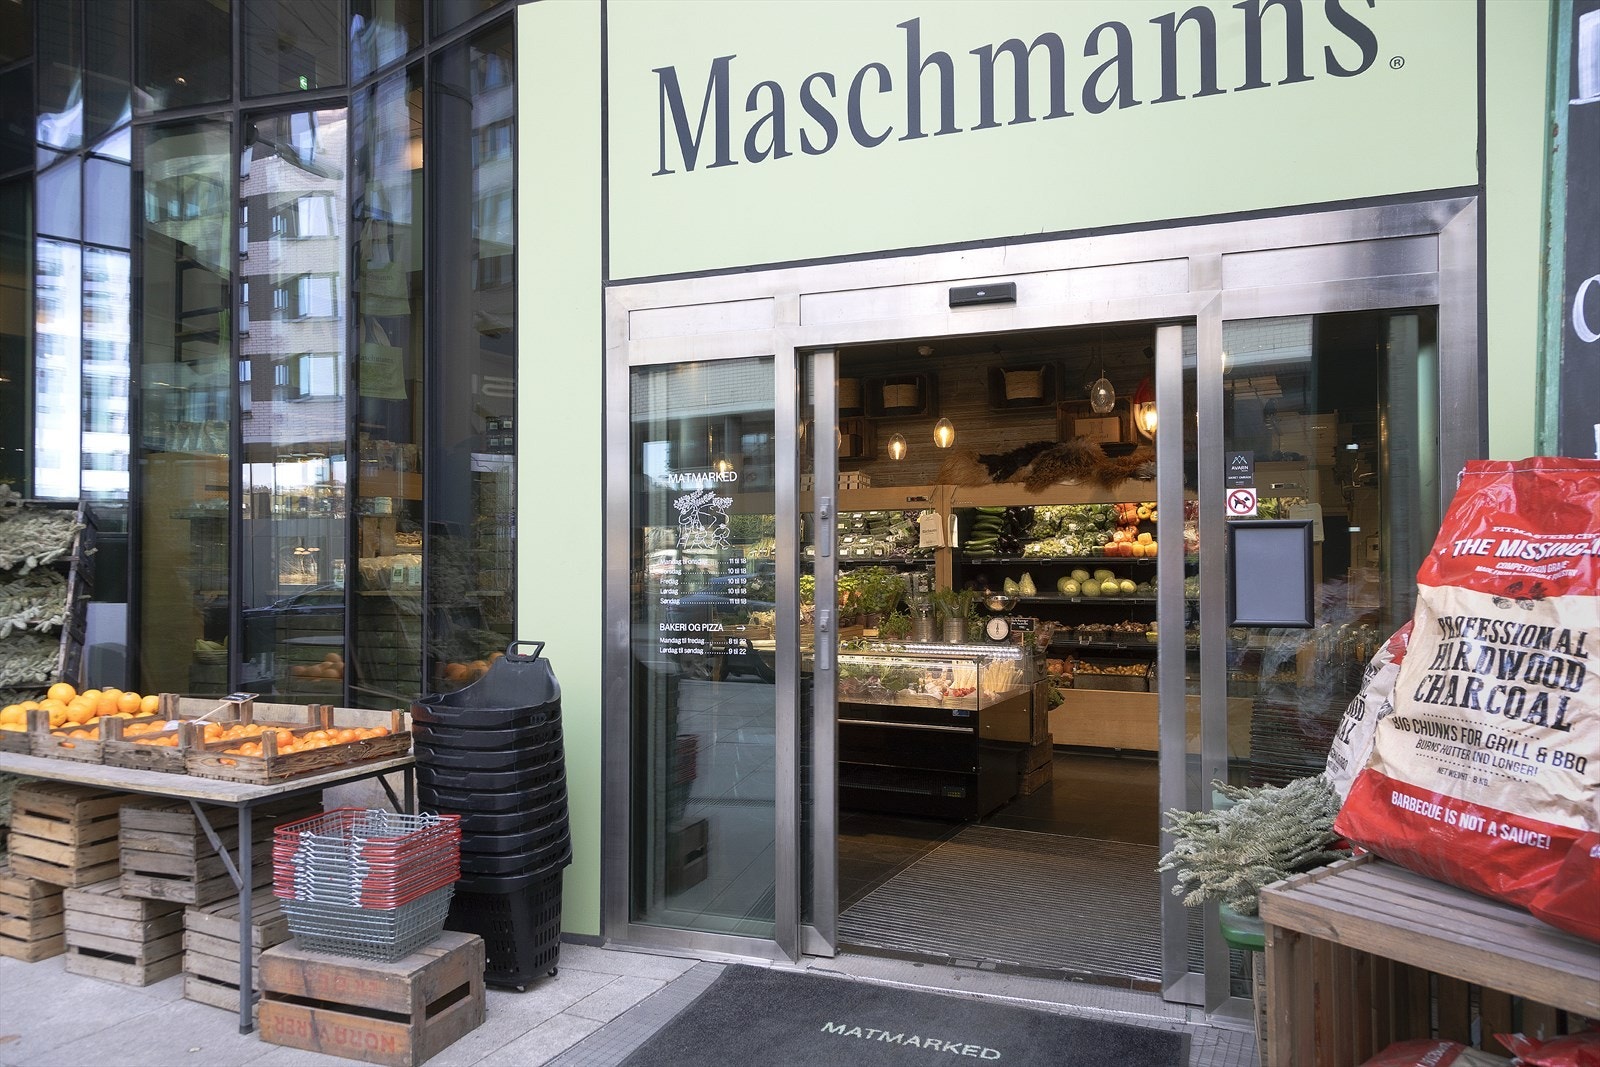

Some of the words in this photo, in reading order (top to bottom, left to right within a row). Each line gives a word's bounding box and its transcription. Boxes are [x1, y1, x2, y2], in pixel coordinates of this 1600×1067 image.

[652, 0, 1379, 176] Maschmanns
[668, 471, 738, 483] MATMARKED
[1491, 526, 1573, 540] PITMASTERS
[1452, 539, 1495, 558] THE
[1496, 561, 1547, 574] COMPETITION
[660, 578, 679, 586] Fredag
[660, 588, 679, 596] Lørdag
[660, 623, 687, 631] BAKERI
[688, 623, 700, 631] OG
[702, 623, 723, 631] PIZZA
[660, 637, 681, 645] Mandag
[688, 637, 705, 645] fredag
[1437, 615, 1589, 659] PROFESSIONAL
[660, 647, 678, 655] Lørdag
[1413, 673, 1573, 733] CHARCOAL
[1392, 715, 1411, 732] BIG
[1412, 718, 1458, 742] CHUNKS
[1460, 727, 1483, 749] FOR
[1485, 733, 1530, 761] GRILL
[1536, 747, 1548, 763] &
[1552, 750, 1588, 775] BBQ
[1415, 738, 1442, 754] BURNS
[1441, 744, 1471, 761] HOTTER
[1492, 756, 1538, 777] LONGER!
[1437, 767, 1448, 775] NET
[1391, 790, 1442, 821] BARBECUE
[1444, 809, 1457, 825] IS
[1459, 814, 1486, 833] NOT
[1487, 823, 1497, 837] A
[1499, 823, 1551, 849] SAUCE!
[820, 1021, 1001, 1060] MATMARKED
